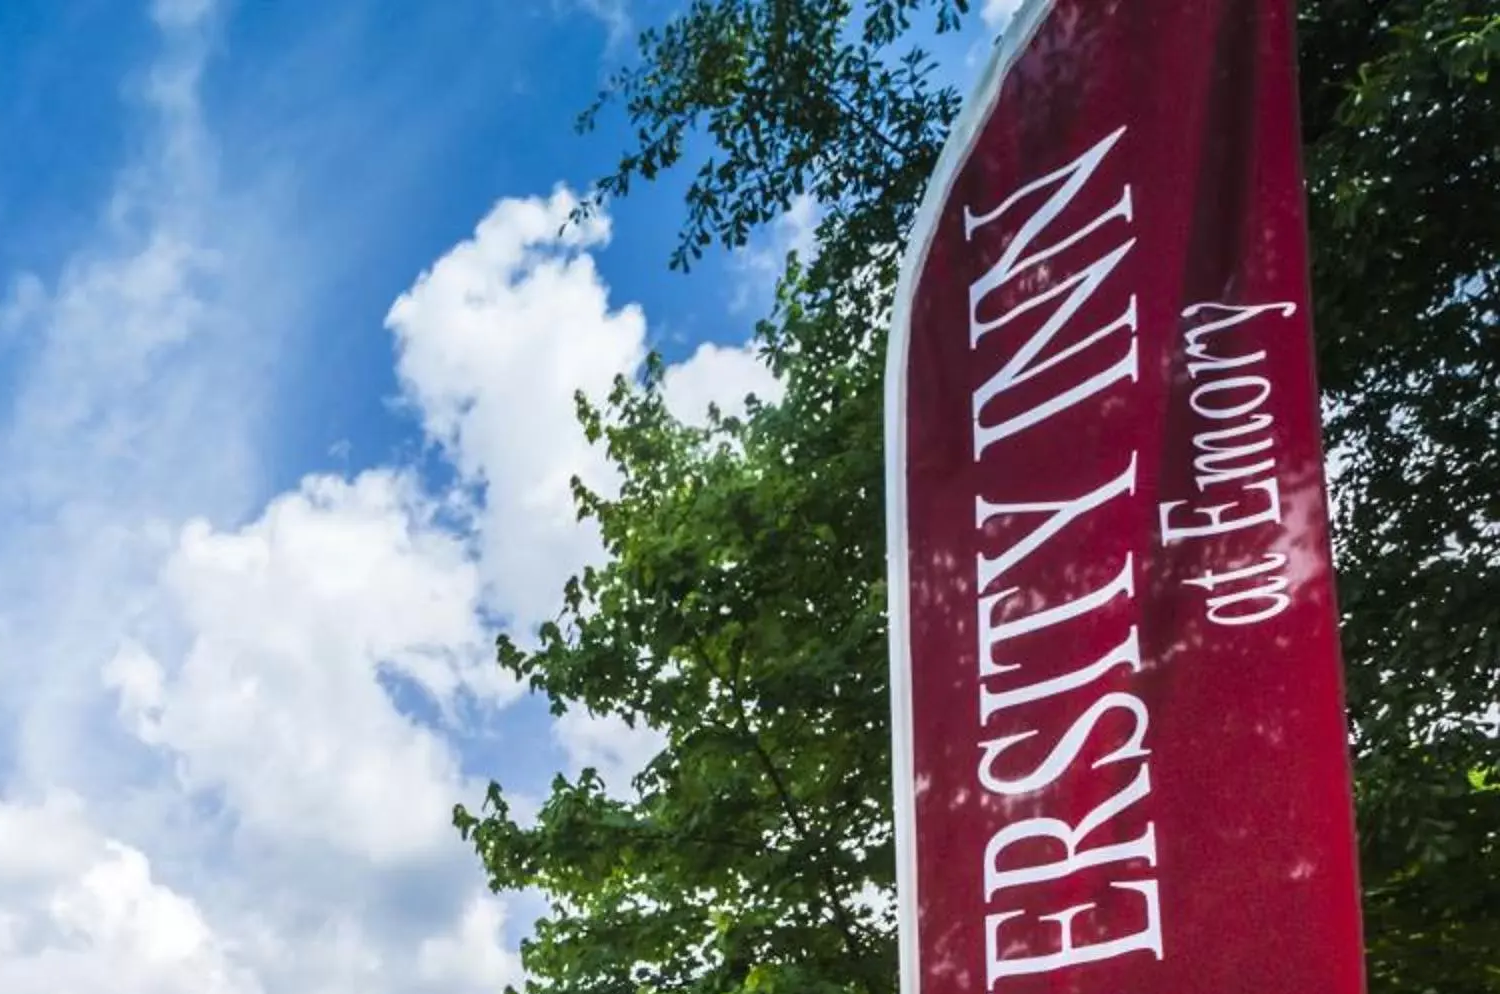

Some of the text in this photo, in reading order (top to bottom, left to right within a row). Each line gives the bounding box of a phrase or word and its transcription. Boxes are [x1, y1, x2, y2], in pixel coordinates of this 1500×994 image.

[963, 125, 1139, 462] INN
[1159, 301, 1297, 627] at Emory
